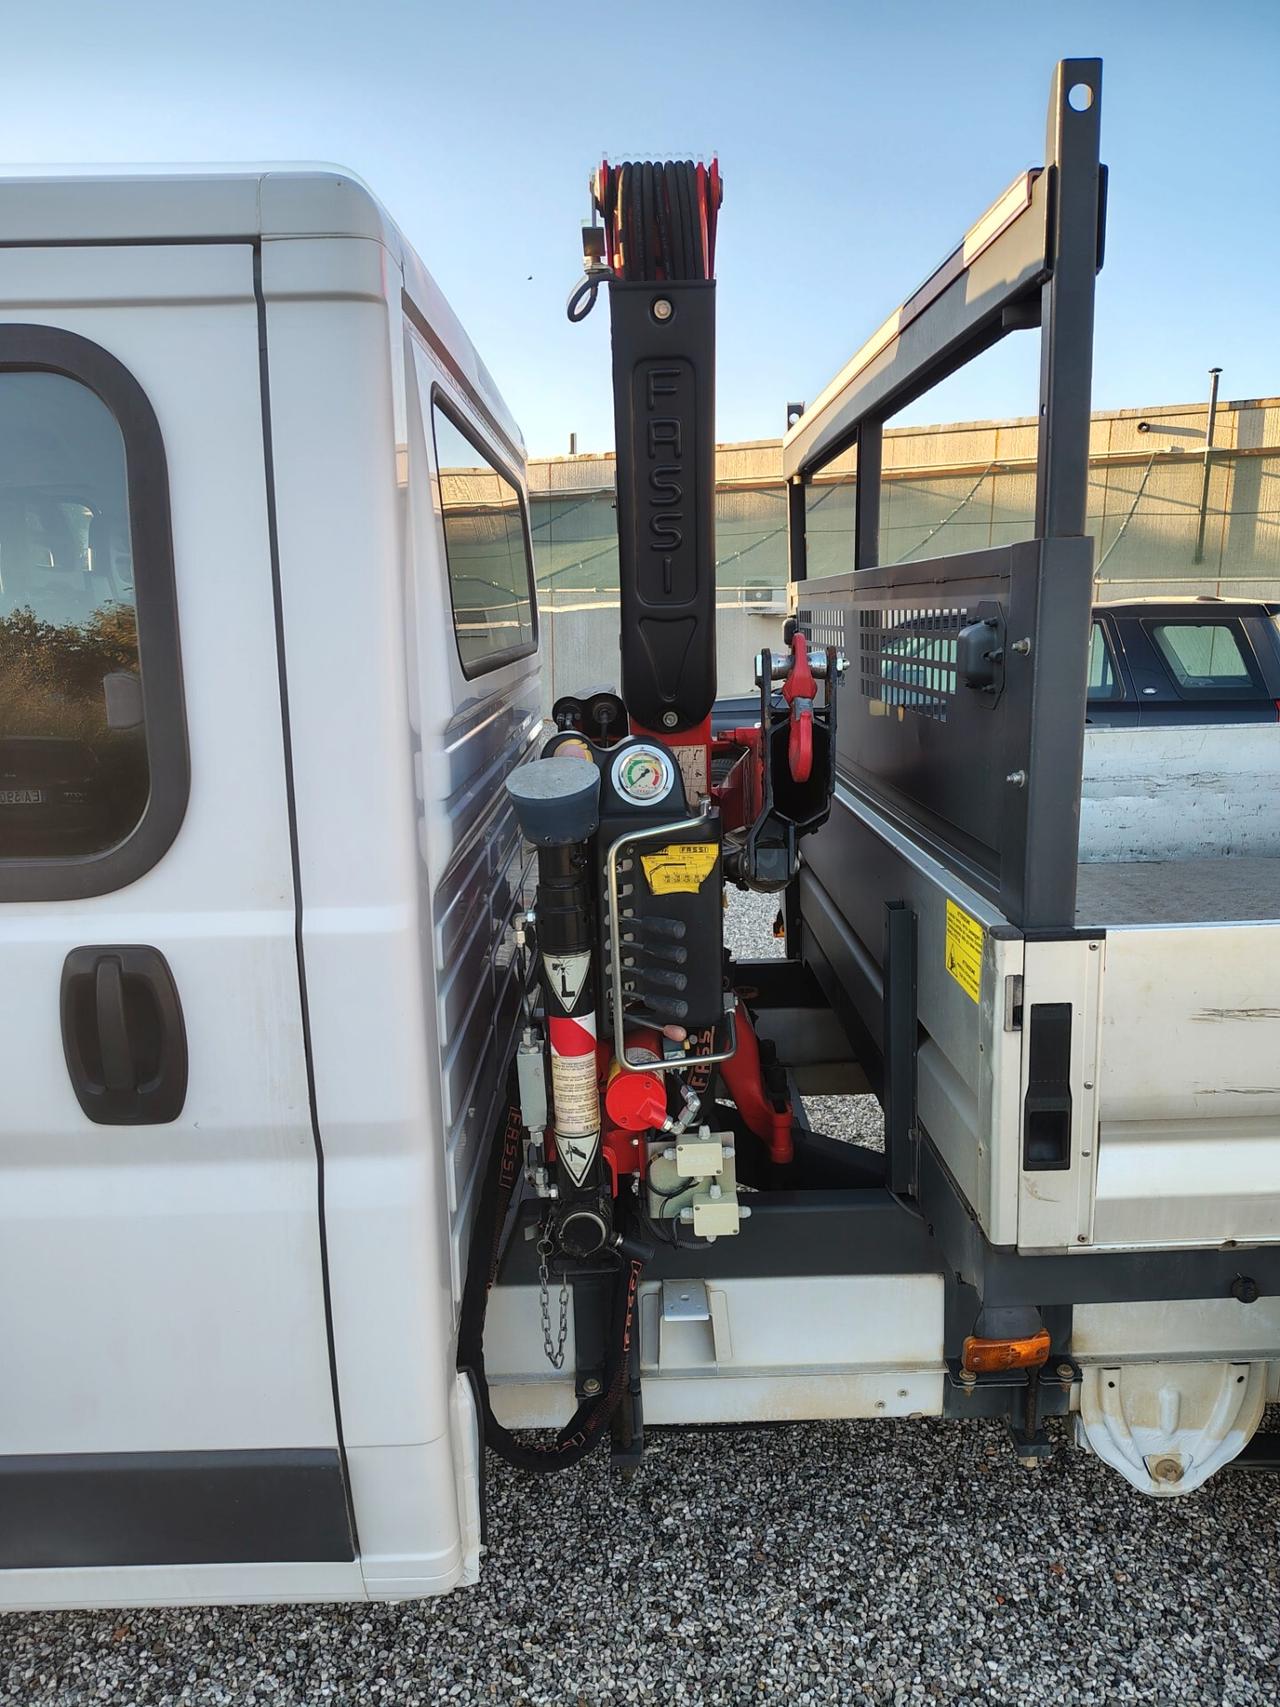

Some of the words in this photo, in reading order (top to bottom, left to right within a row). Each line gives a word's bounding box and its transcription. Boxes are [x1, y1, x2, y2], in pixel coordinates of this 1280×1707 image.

[647, 369, 684, 593] FASSI
[681, 846, 707, 854] FASSI
[502, 1112, 522, 1181] FASSI
